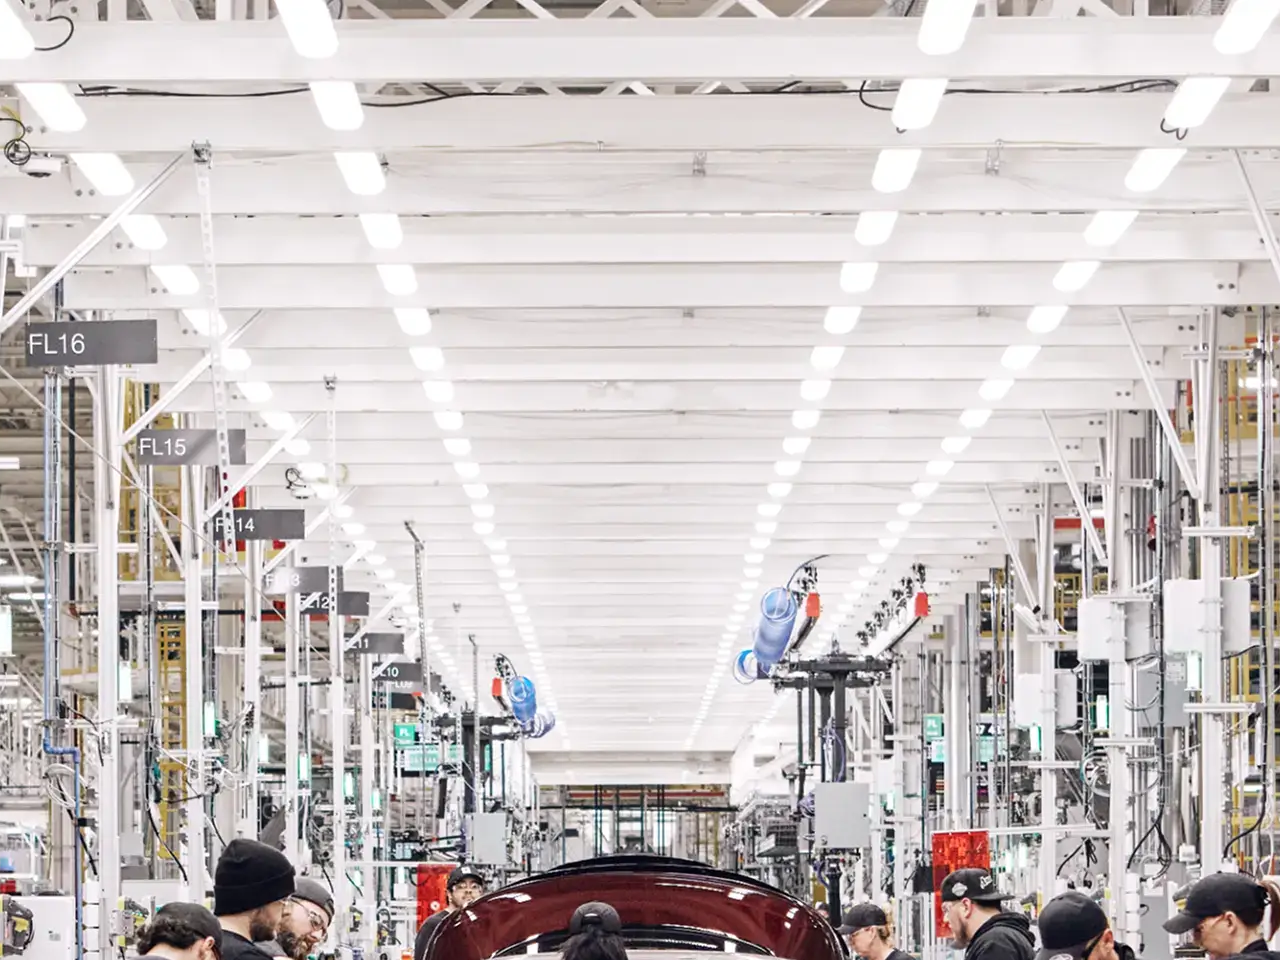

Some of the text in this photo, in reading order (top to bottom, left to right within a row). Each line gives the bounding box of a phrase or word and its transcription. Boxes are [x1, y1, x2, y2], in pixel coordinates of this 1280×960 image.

[29, 333, 86, 354] FL16
[139, 438, 187, 455] FL15
[215, 517, 255, 532] F14
[265, 573, 300, 587] F3
